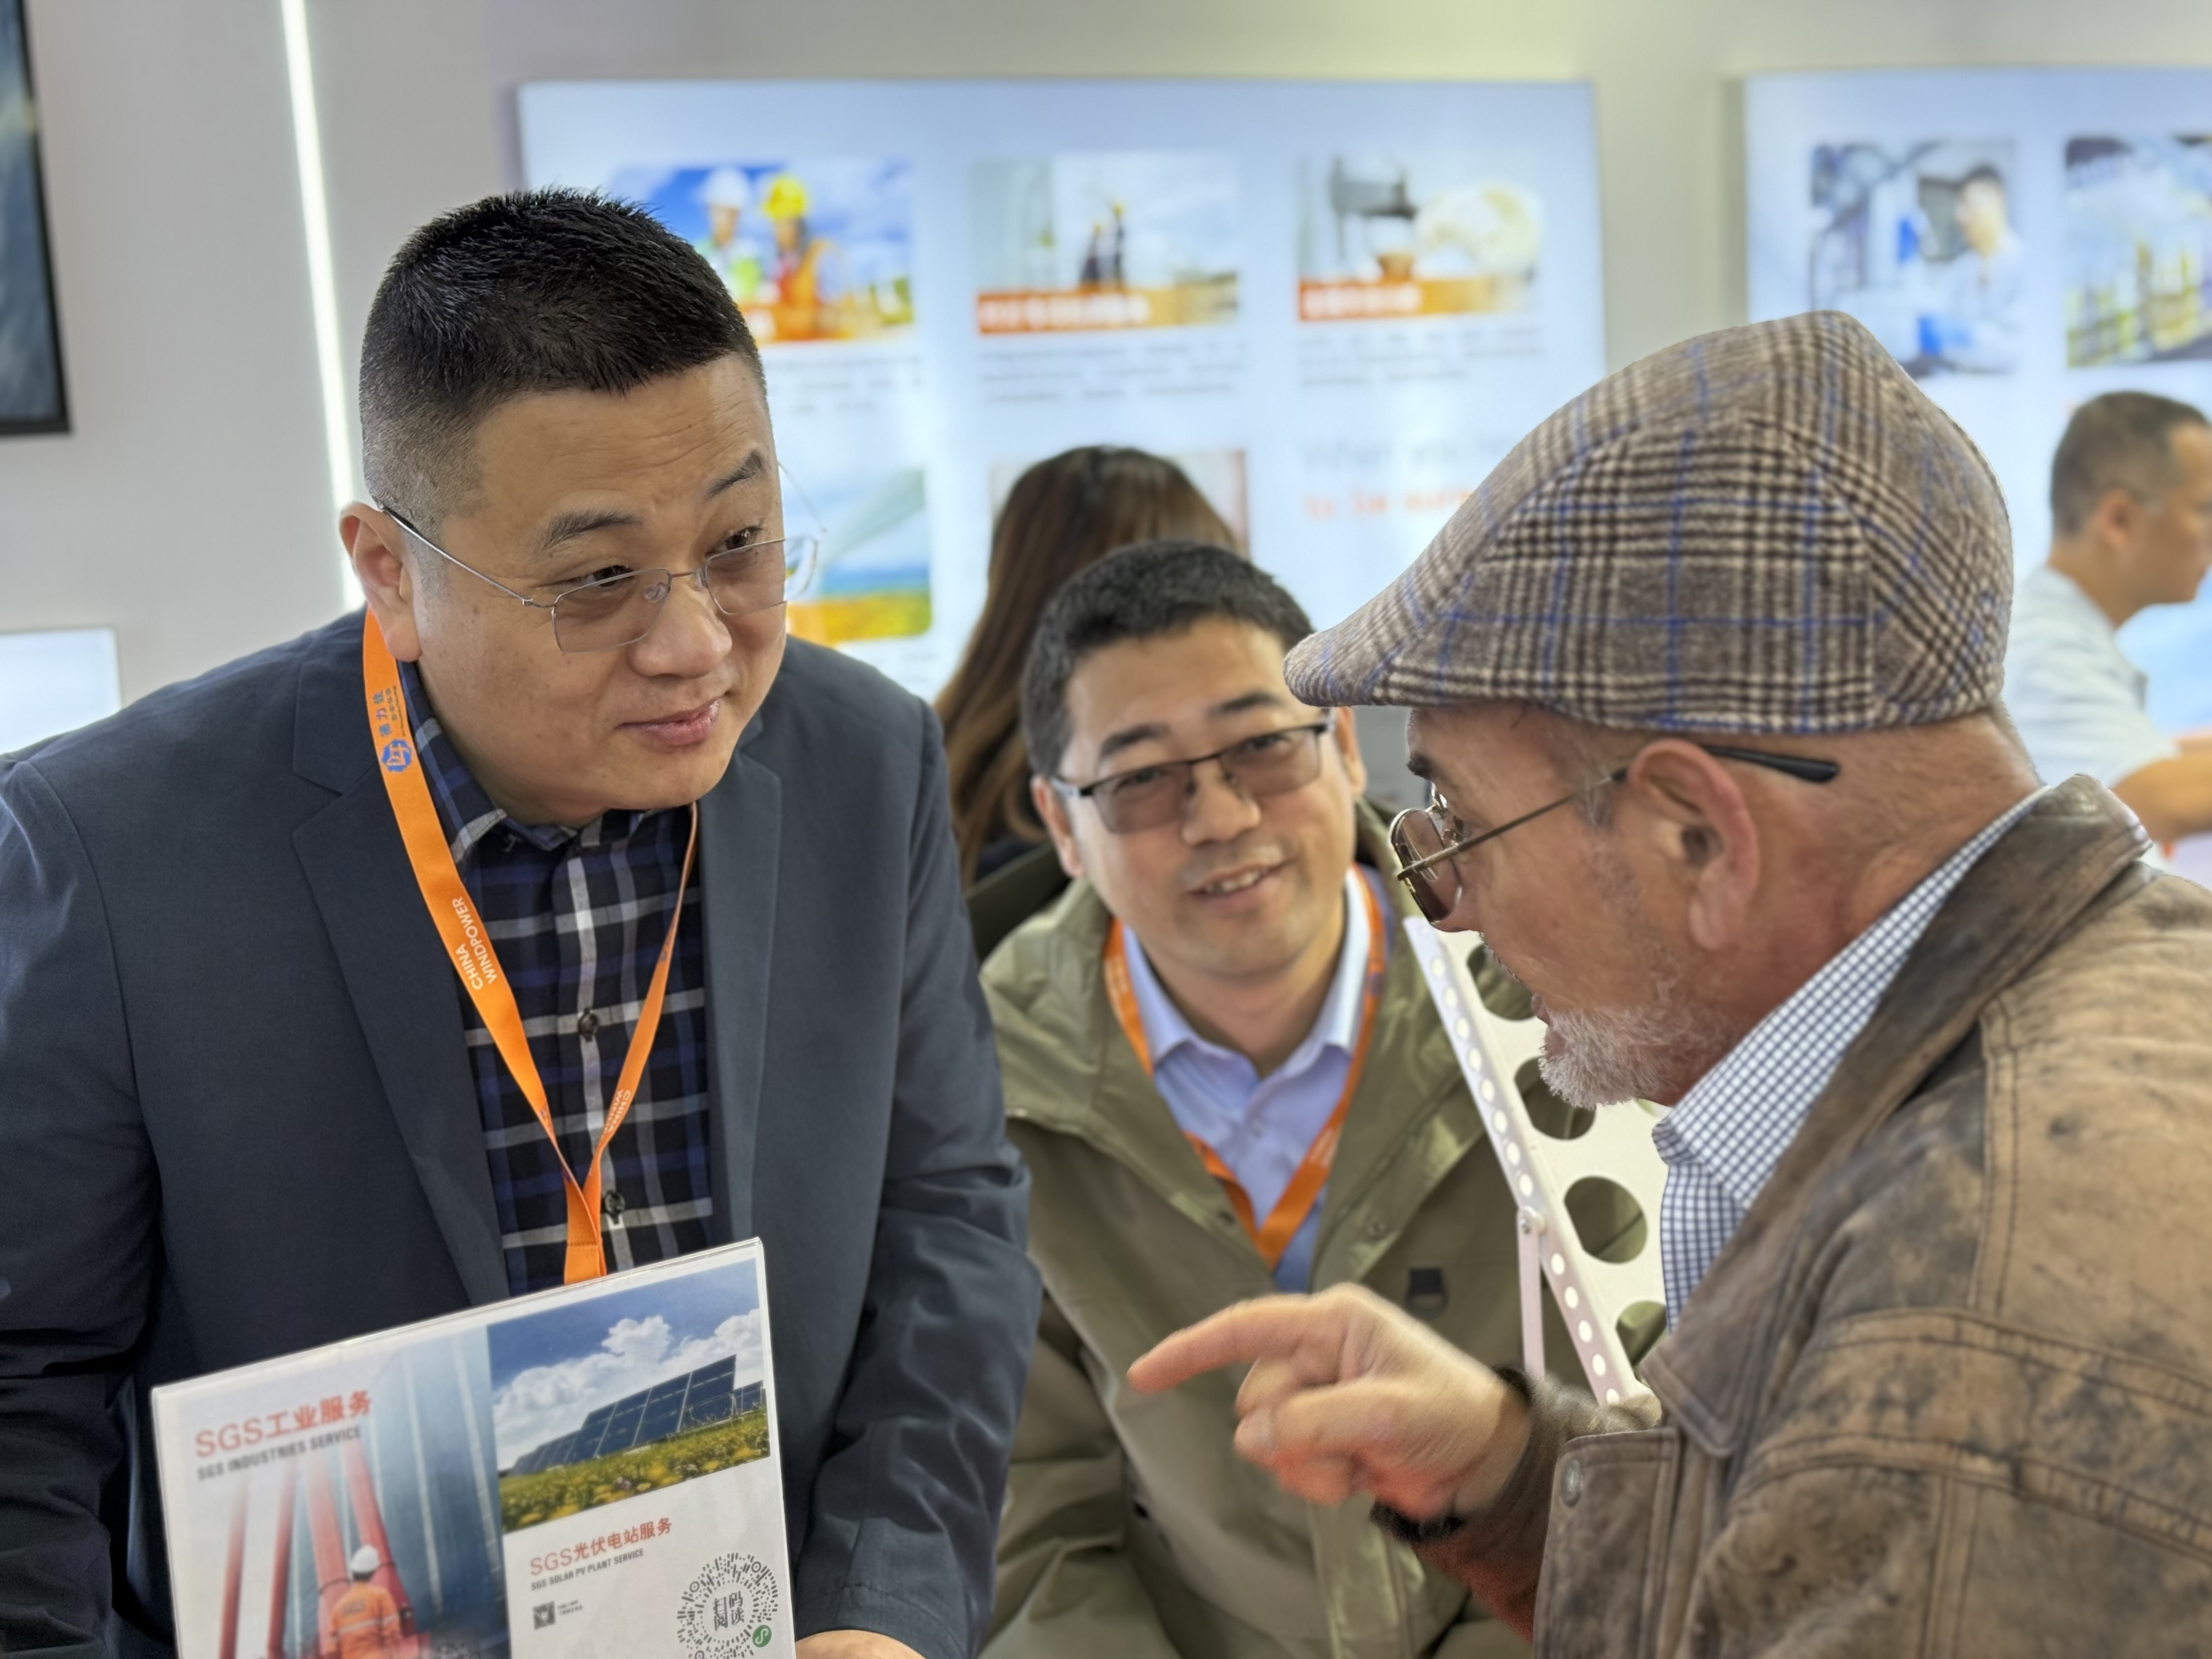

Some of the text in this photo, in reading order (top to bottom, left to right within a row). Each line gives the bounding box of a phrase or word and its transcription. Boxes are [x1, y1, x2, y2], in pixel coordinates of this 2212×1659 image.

[452, 897, 497, 984] WINDPOWER
[456, 943, 483, 990] CHINA
[607, 1090, 631, 1132] CHINA
[195, 1390, 371, 1458] SGS工业服务
[197, 1425, 361, 1481] SGS INDUSTRIES SERVICE
[530, 1517, 672, 1576] SGS光伏电站服务
[531, 1548, 644, 1591] SGS SOLAR PV PLANT SERVICE
